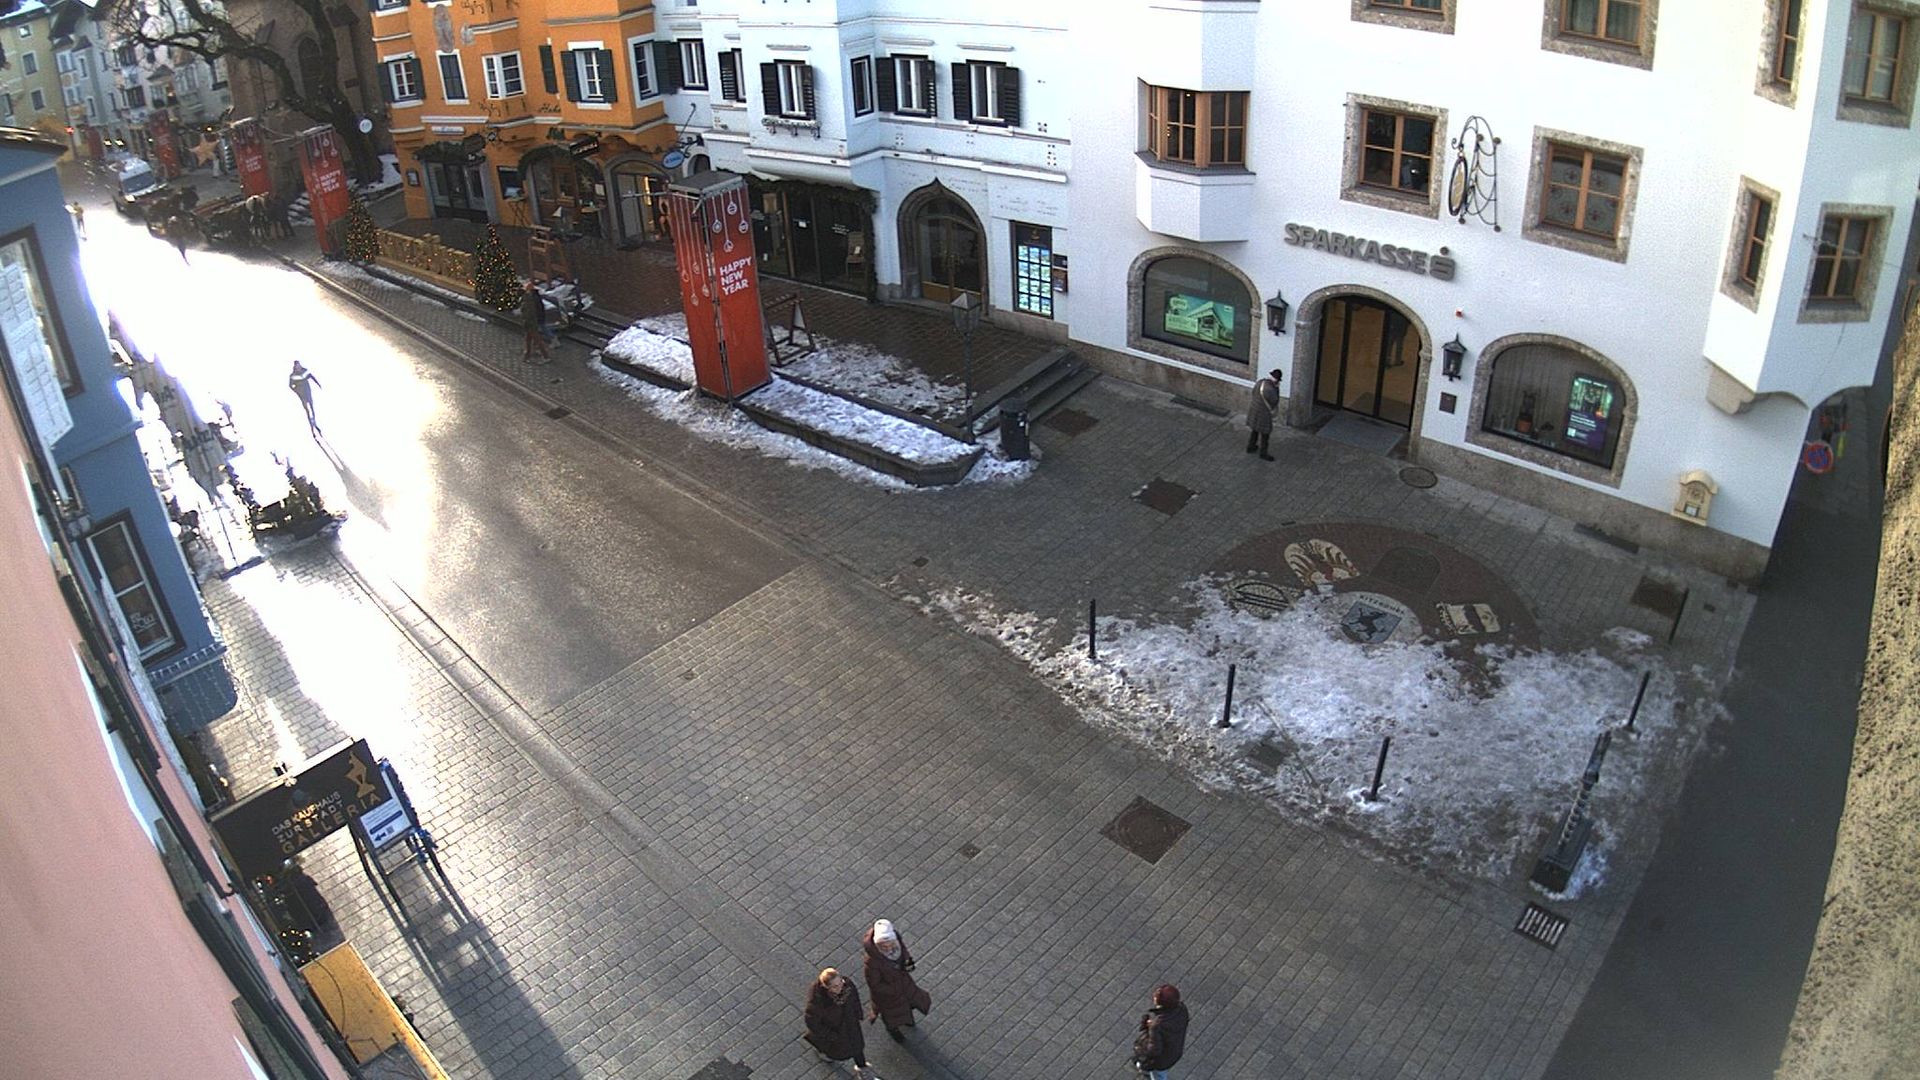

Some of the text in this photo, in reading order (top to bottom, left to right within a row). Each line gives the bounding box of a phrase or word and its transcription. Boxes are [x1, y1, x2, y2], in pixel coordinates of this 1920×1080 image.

[719, 256, 752, 276] HAPPY
[1284, 223, 1427, 275] SPARKASSE
[721, 270, 743, 286] NEW
[722, 279, 749, 295] YEAR
[272, 818, 291, 835] DAS
[291, 791, 341, 822] KAUFHAUS
[277, 824, 303, 843] ZUR
[304, 800, 343, 828] STADT
[282, 792, 381, 854] GALLERIA
